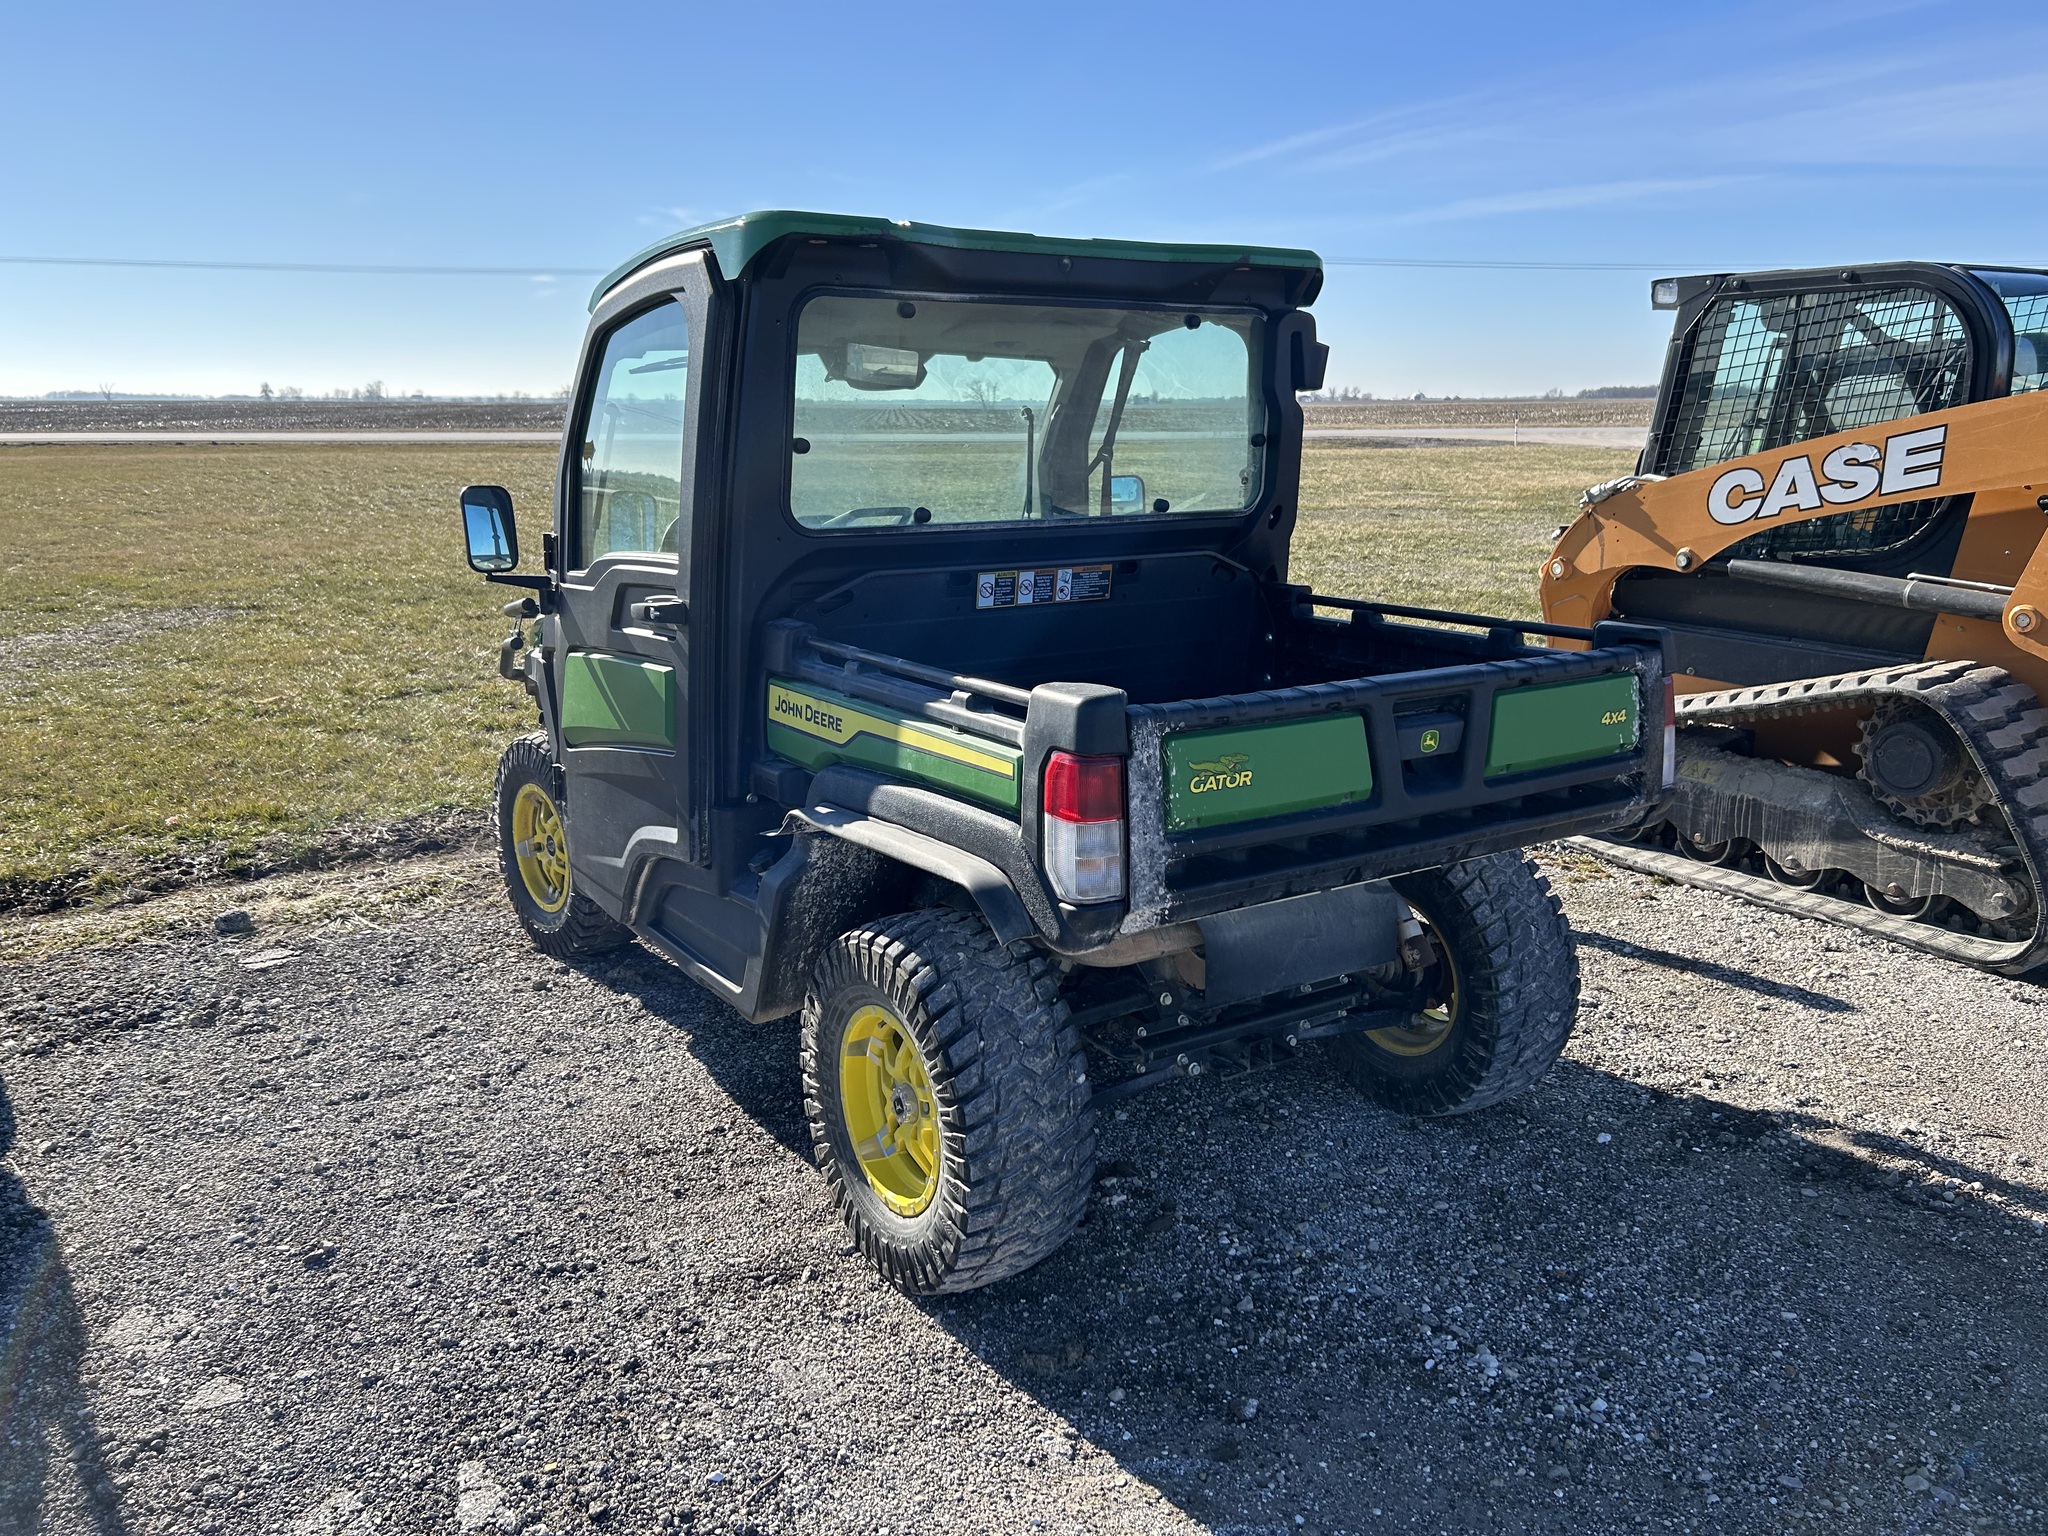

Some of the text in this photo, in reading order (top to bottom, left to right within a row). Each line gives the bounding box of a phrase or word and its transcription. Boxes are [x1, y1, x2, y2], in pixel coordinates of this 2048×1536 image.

[1707, 424, 1948, 525] CASE
[775, 695, 843, 733] JOHN DEERE
[1190, 770, 1253, 793] GATOR
